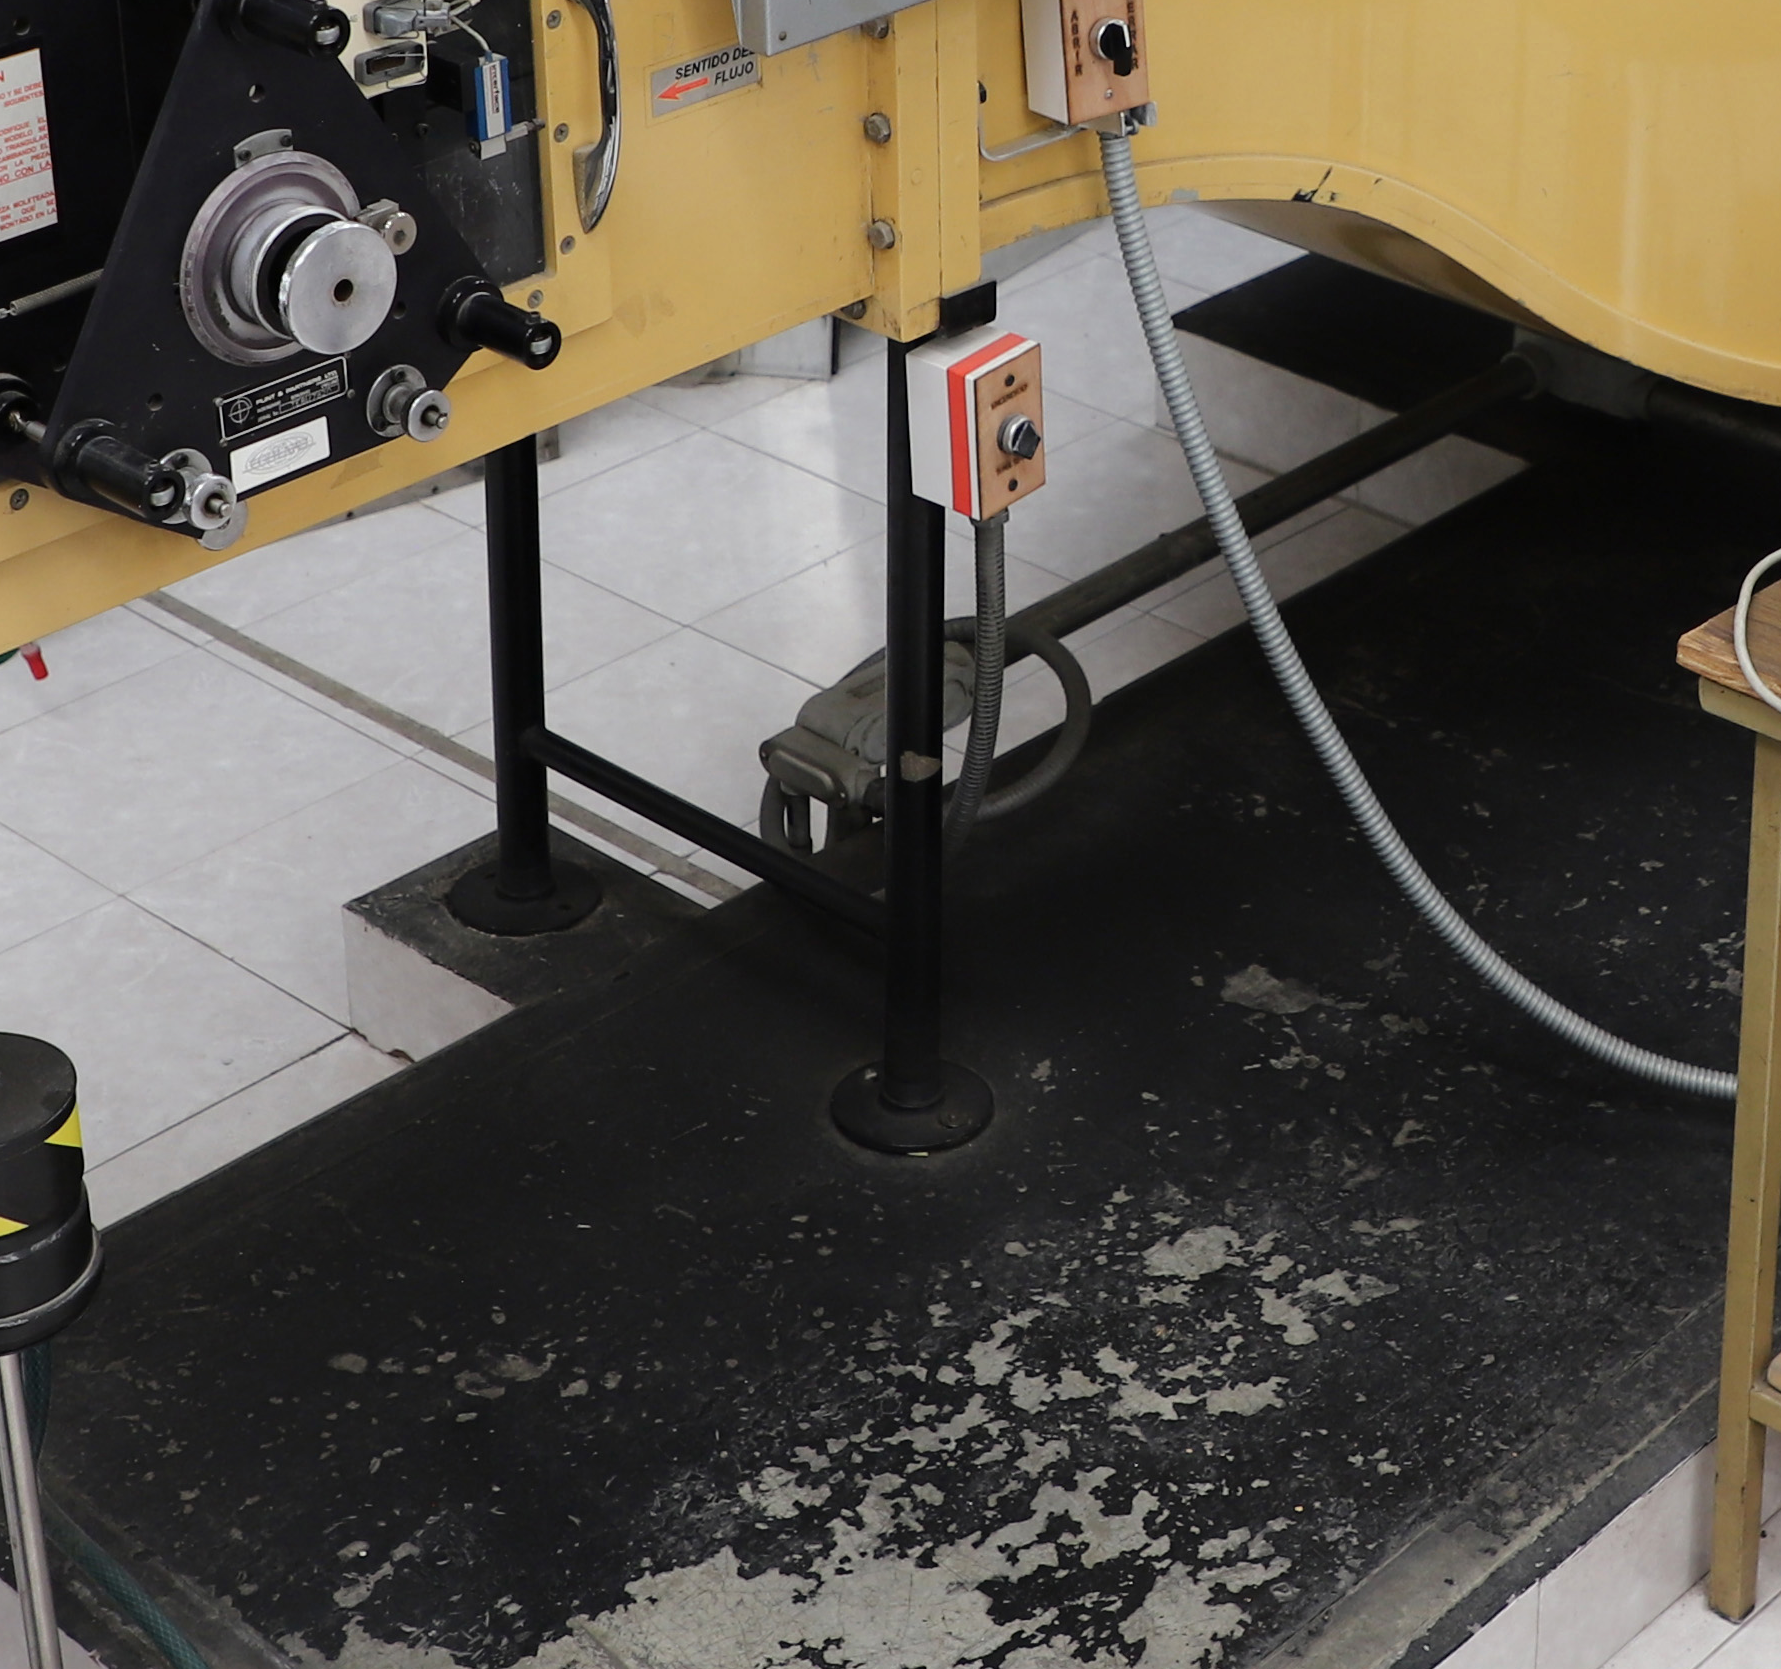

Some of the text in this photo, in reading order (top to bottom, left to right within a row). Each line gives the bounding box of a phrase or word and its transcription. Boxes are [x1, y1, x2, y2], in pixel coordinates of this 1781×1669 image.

[1071, 9, 1082, 76] ABRIR
[675, 52, 729, 80] SENTIDO
[715, 61, 753, 85] FLUJO
[15, 166, 34, 177] CON
[39, 160, 51, 168] LA
